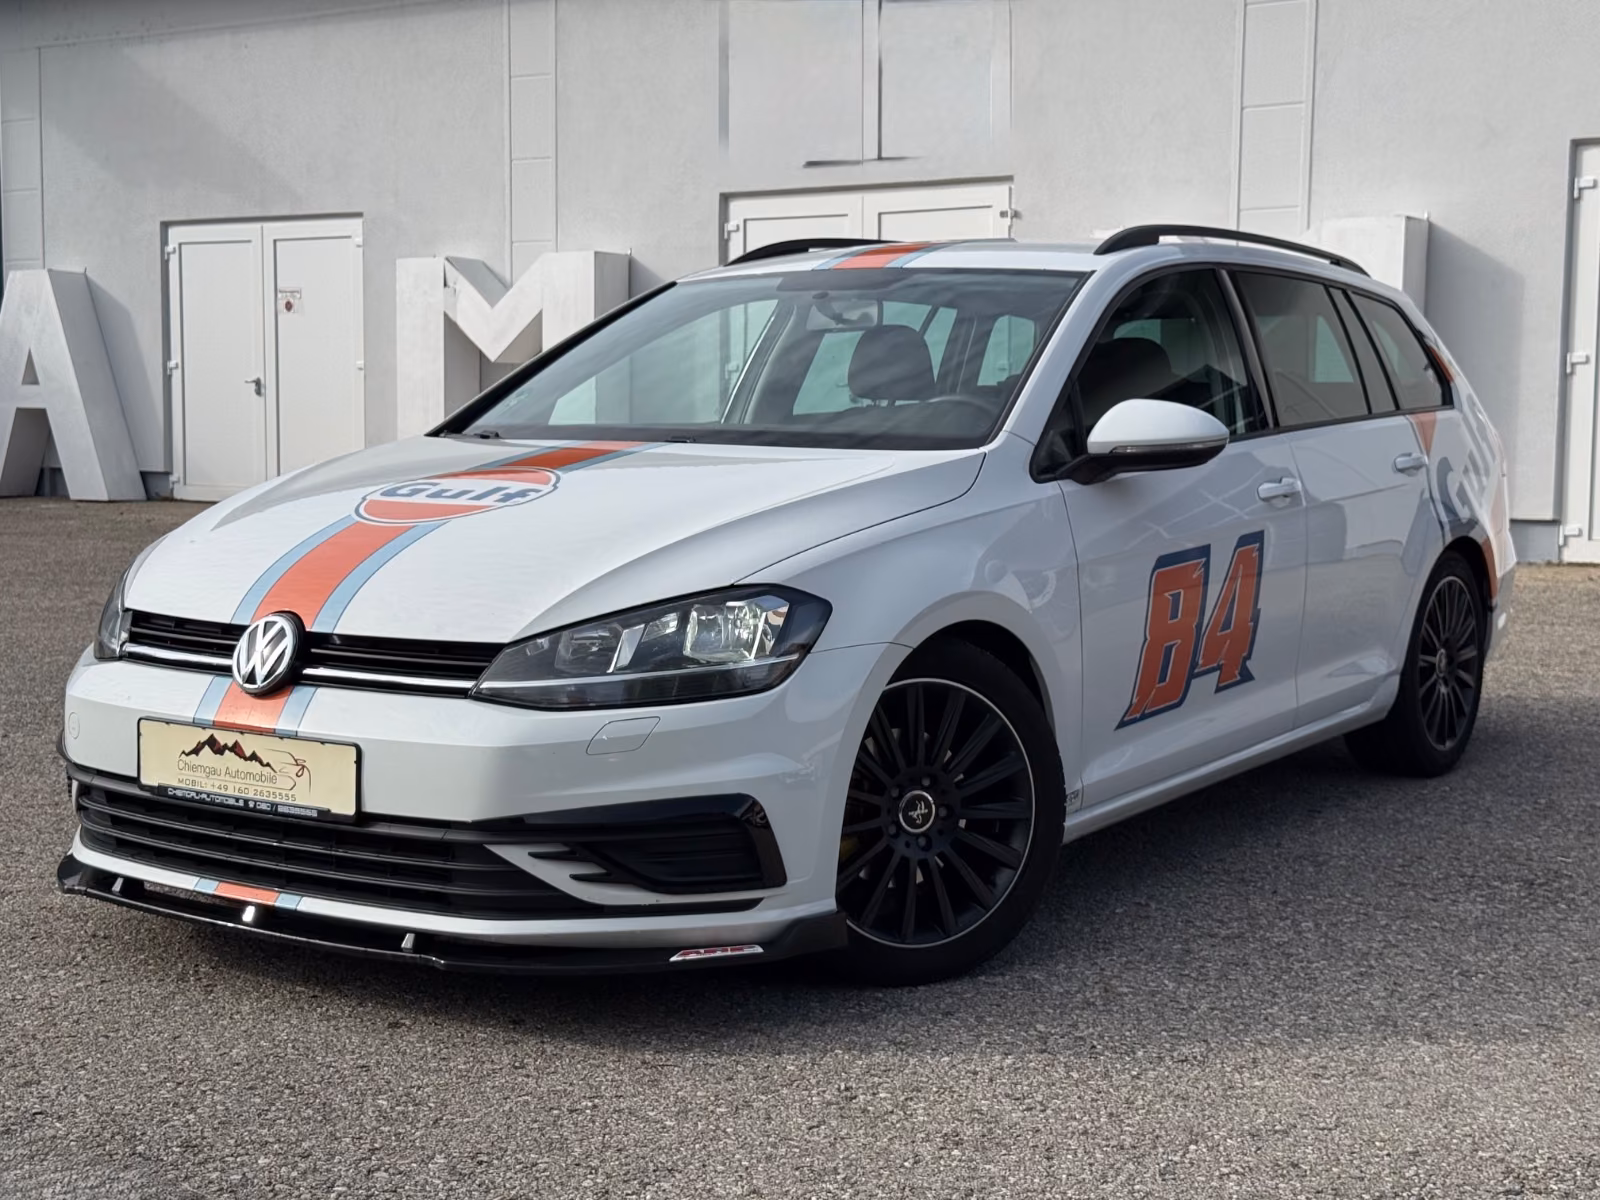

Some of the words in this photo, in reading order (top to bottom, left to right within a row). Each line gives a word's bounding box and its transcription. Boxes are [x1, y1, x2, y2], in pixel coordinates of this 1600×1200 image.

[0, 268, 140, 501] A
[379, 481, 544, 504] Gulf
[232, 614, 294, 689] VW
[1113, 529, 1265, 731] 84
[177, 758, 222, 778] Chiemgau
[224, 766, 278, 785] Automobile
[177, 777, 208, 789] MOBIL:
[210, 780, 229, 792] +49
[232, 785, 250, 796] 160
[253, 788, 297, 802] 2635555
